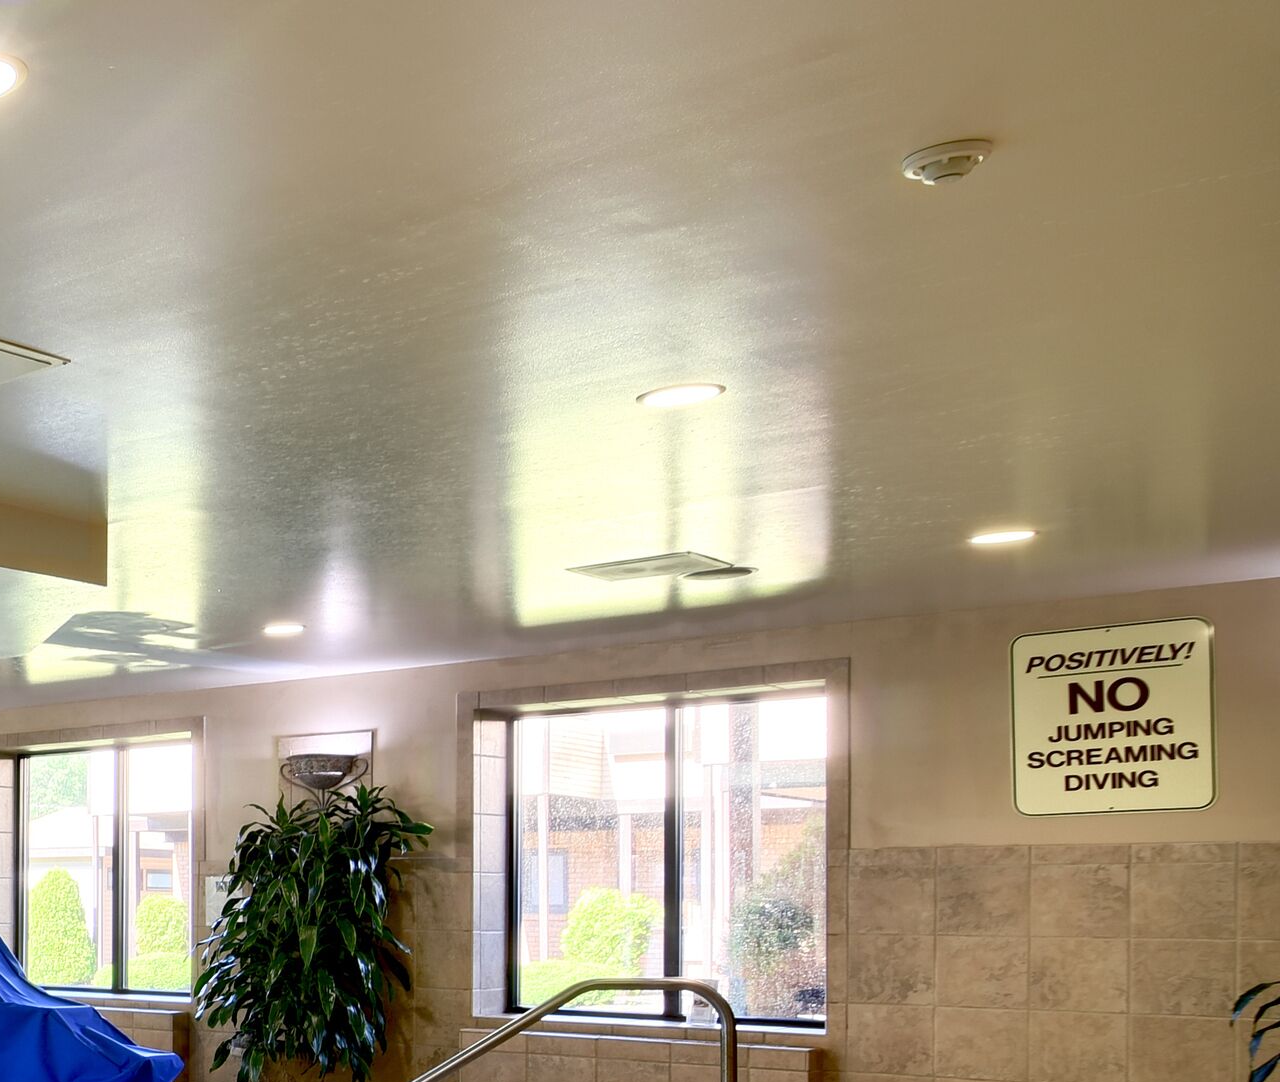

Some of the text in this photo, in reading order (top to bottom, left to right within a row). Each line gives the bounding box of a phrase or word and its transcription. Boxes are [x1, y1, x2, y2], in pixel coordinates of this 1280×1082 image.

[1025, 641, 1195, 674] POSITIVELY!
[1067, 676, 1150, 715] NO
[1048, 717, 1175, 743] JUMPING
[1027, 741, 1200, 769] SCREAMING
[1064, 769, 1160, 792] DIVING
